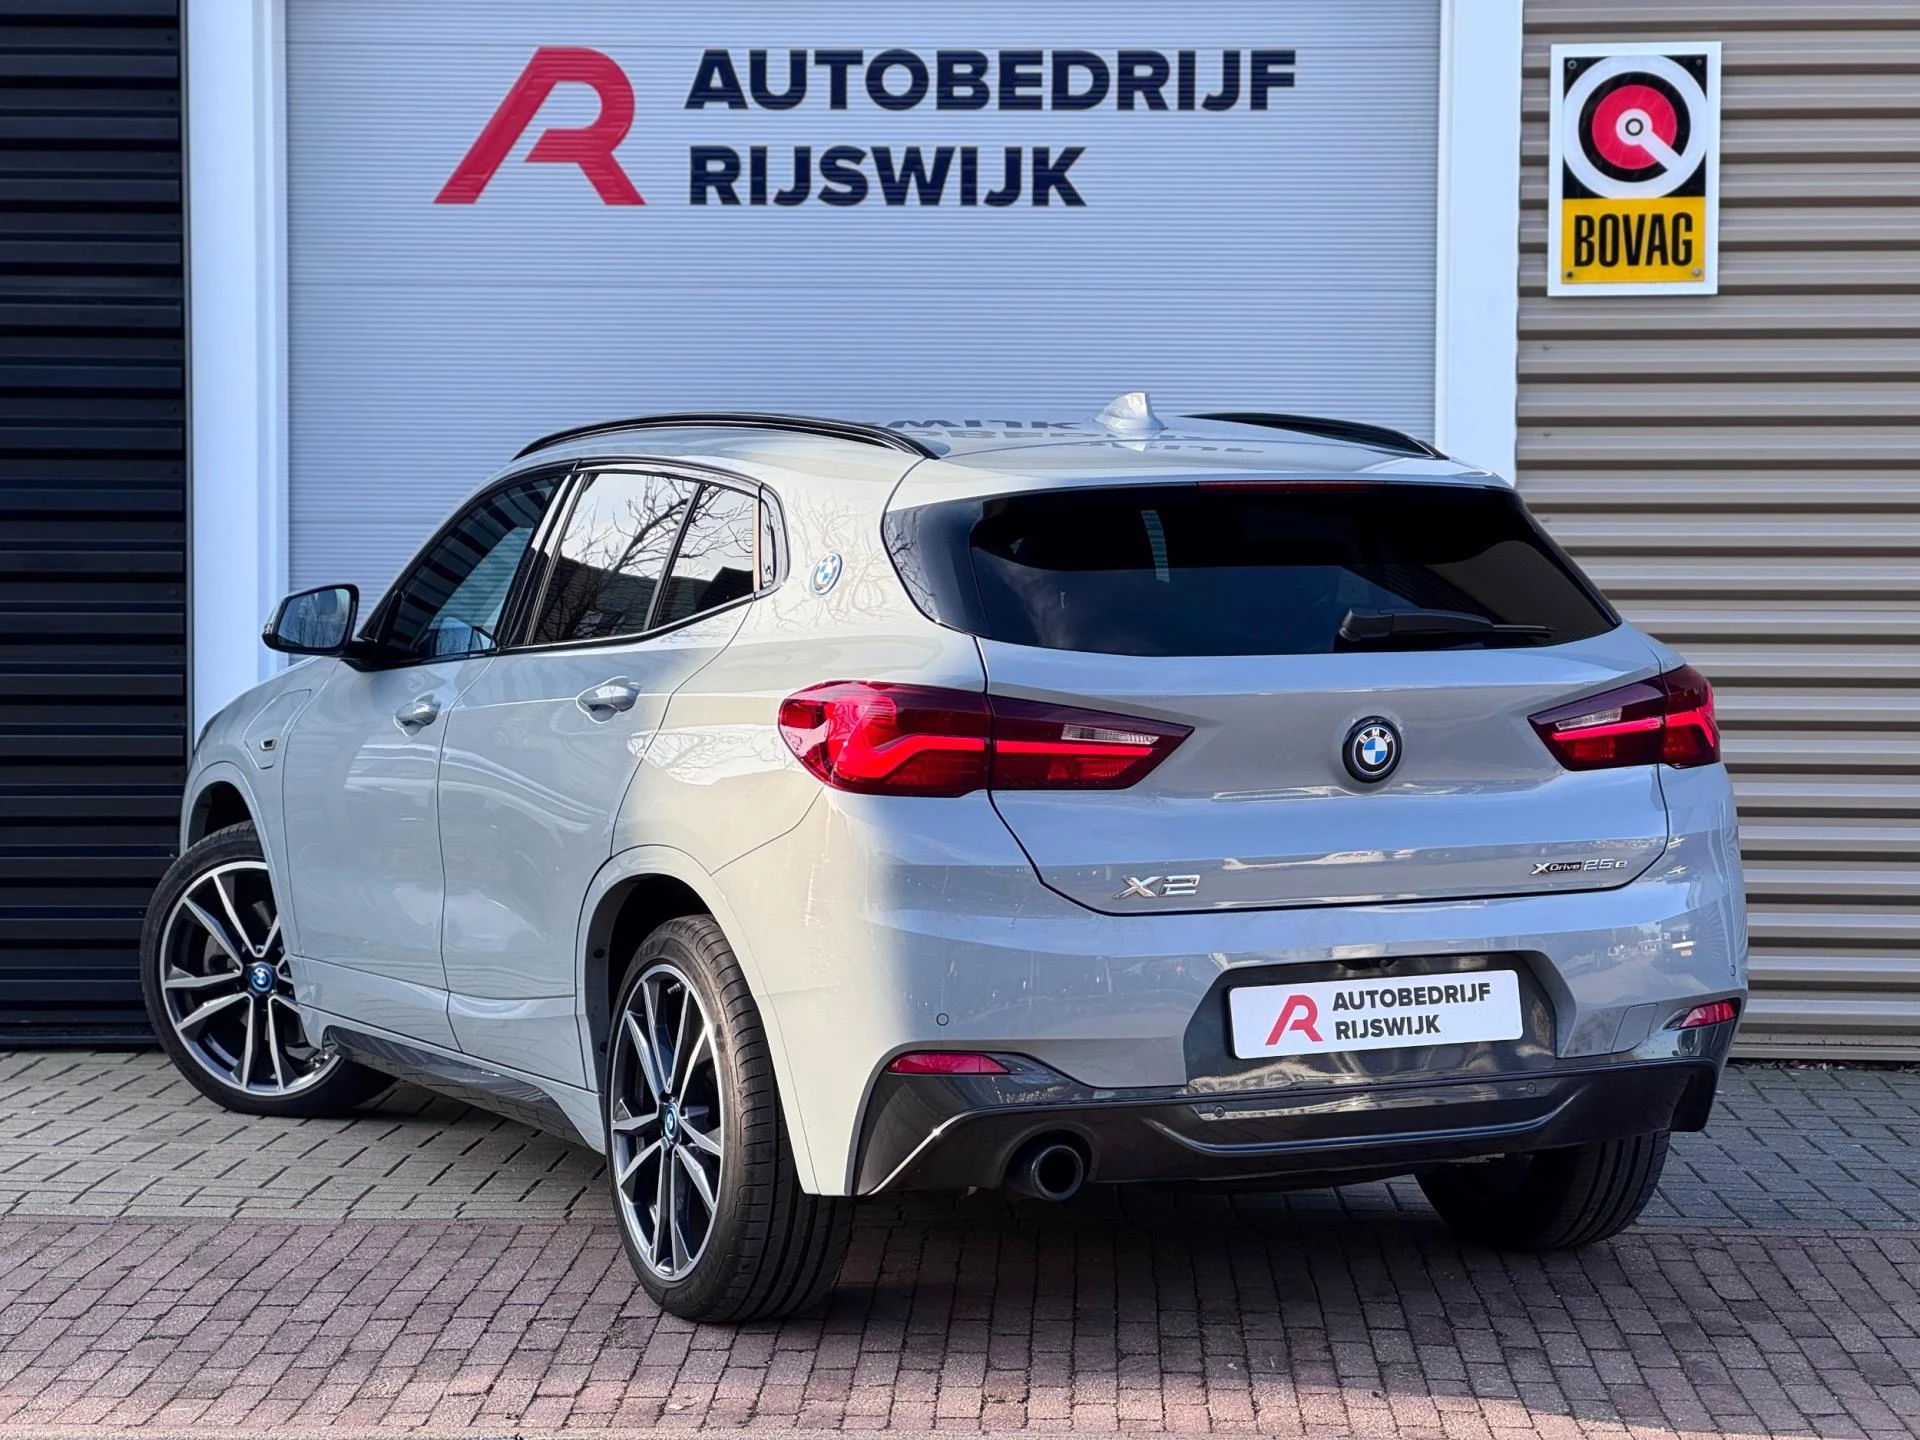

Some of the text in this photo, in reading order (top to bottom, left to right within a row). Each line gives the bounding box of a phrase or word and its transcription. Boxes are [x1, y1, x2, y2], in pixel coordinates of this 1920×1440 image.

[685, 49, 1296, 112] AUTOBEDRIJF
[690, 145, 1086, 207] RIJSWIJK
[1574, 212, 1693, 268] BOVAG
[1359, 728, 1393, 744] BMW
[1112, 874, 1200, 899] X2
[1332, 982, 1491, 1012] AUTOBEDRIJF
[1335, 1014, 1441, 1040] RIJSWIJK
